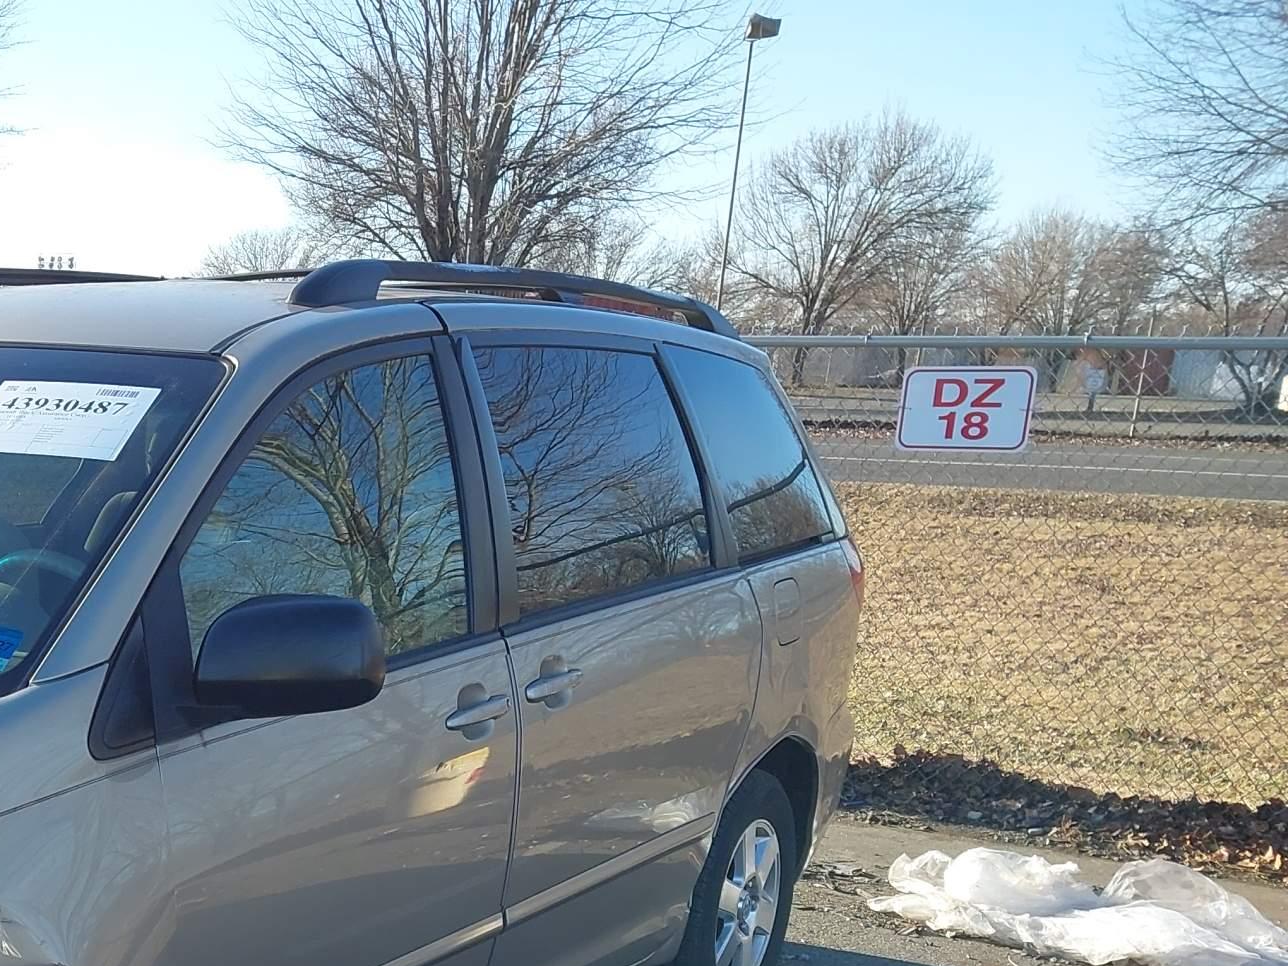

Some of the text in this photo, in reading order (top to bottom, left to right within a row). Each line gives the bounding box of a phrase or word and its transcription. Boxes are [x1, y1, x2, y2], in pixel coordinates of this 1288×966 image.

[1, 396, 130, 415] 43930487
[932, 378, 1006, 408] DZ
[938, 411, 990, 441] 18
